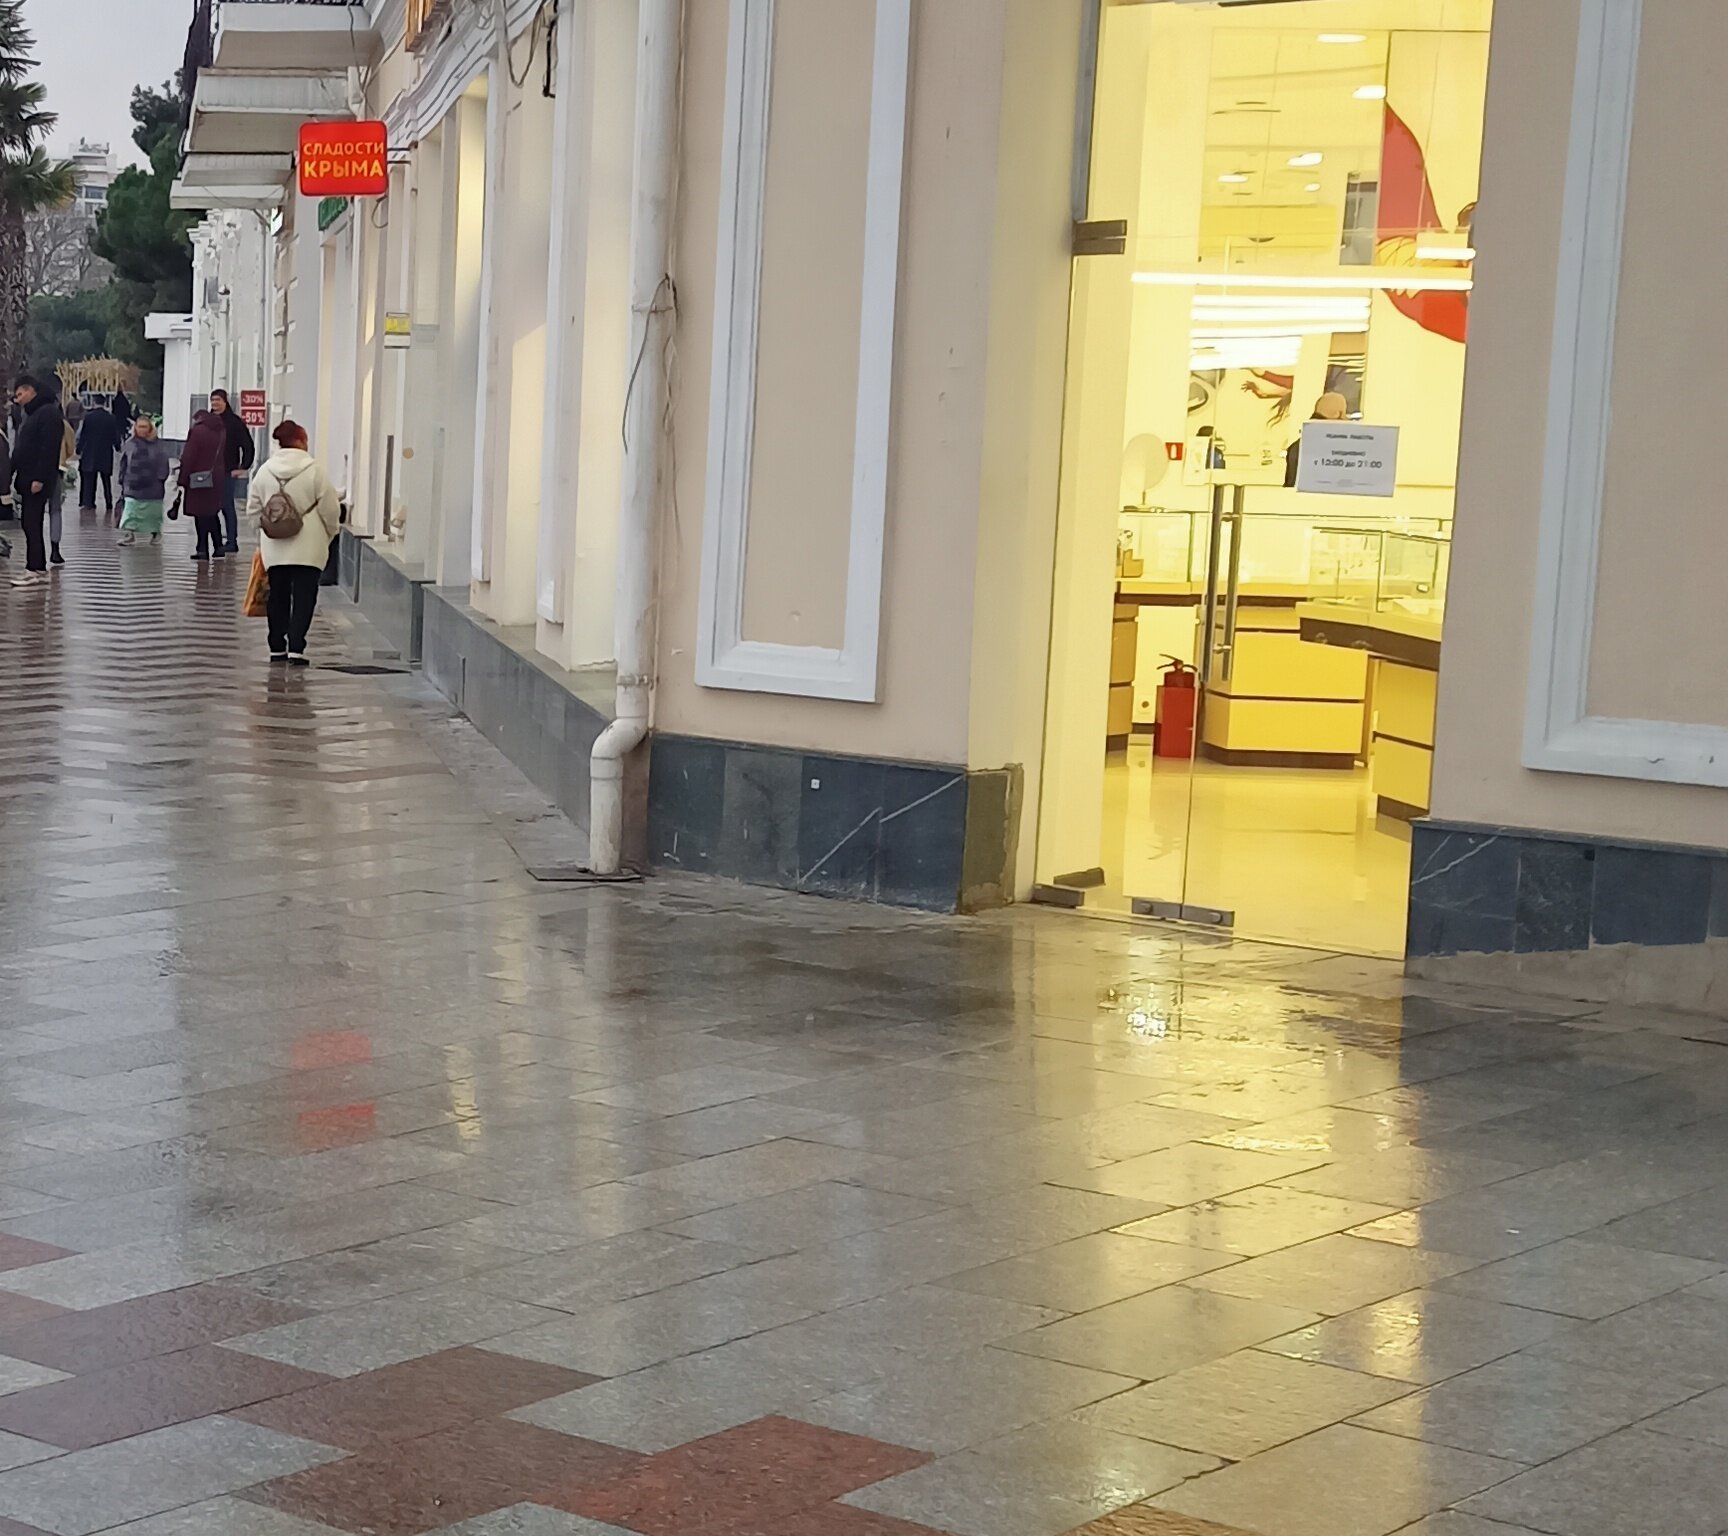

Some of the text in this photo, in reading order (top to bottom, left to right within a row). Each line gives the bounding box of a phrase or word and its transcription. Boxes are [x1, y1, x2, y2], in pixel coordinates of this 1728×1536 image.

[303, 142, 384, 156] СЛАДОСТИ
[304, 159, 384, 178] КРЫМА
[242, 411, 265, 423] -50%
